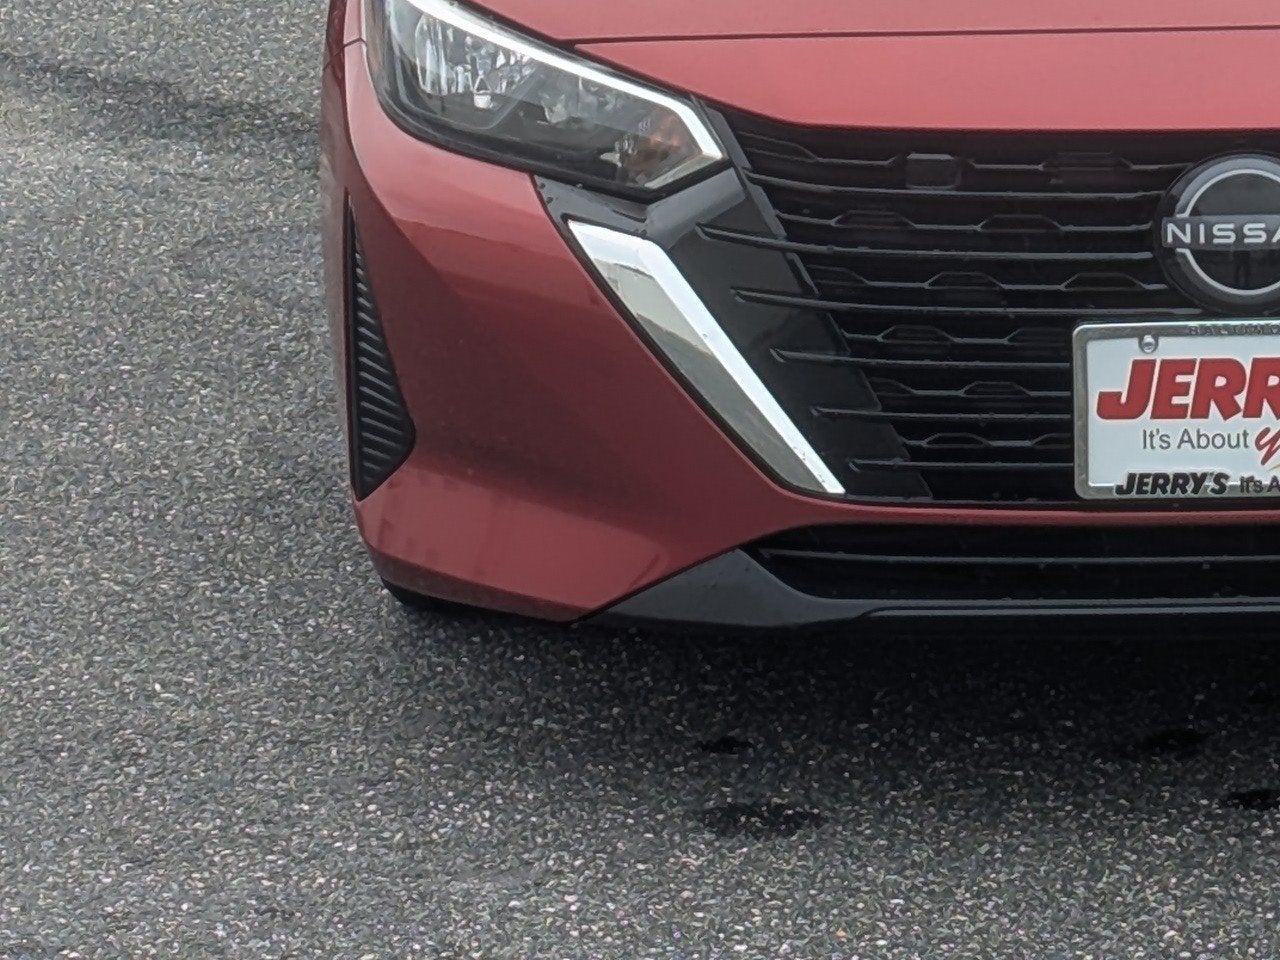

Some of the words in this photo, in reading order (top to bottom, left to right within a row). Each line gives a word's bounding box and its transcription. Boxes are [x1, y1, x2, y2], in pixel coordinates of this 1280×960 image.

[1142, 429, 1171, 450] It's
[1177, 428, 1249, 450] About
[1115, 471, 1231, 496] JERRY'S
